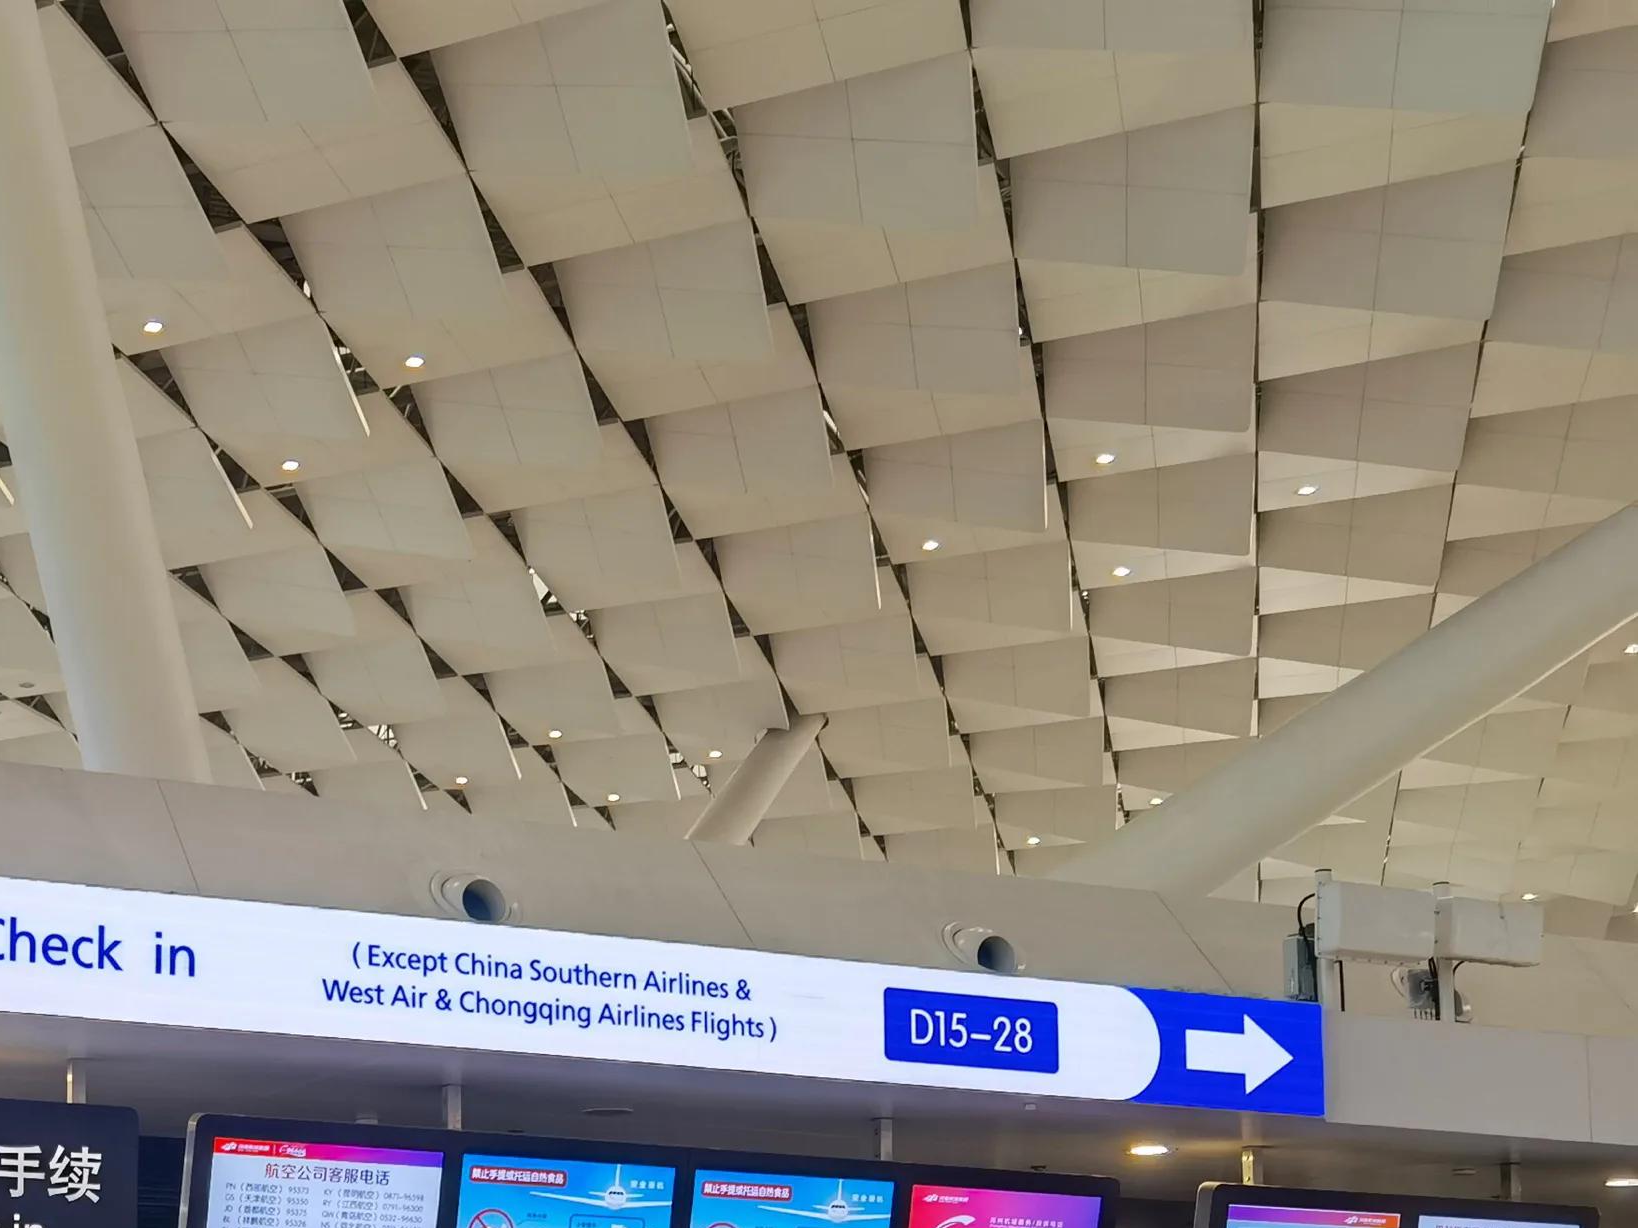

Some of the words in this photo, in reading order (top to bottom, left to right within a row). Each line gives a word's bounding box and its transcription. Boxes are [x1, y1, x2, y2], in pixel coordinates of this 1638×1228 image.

[154, 931, 196, 977] in
[455, 951, 523, 980] China
[530, 957, 637, 991] Southern
[644, 969, 729, 999] Airlines
[736, 978, 751, 1000] &
[322, 979, 383, 1006] West
[394, 984, 425, 1010] Air
[436, 989, 452, 1011] &
[459, 990, 591, 1028] Chongqing
[598, 1002, 684, 1032] Airlines
[265, 1162, 390, 1186] 航空公司客服电话
